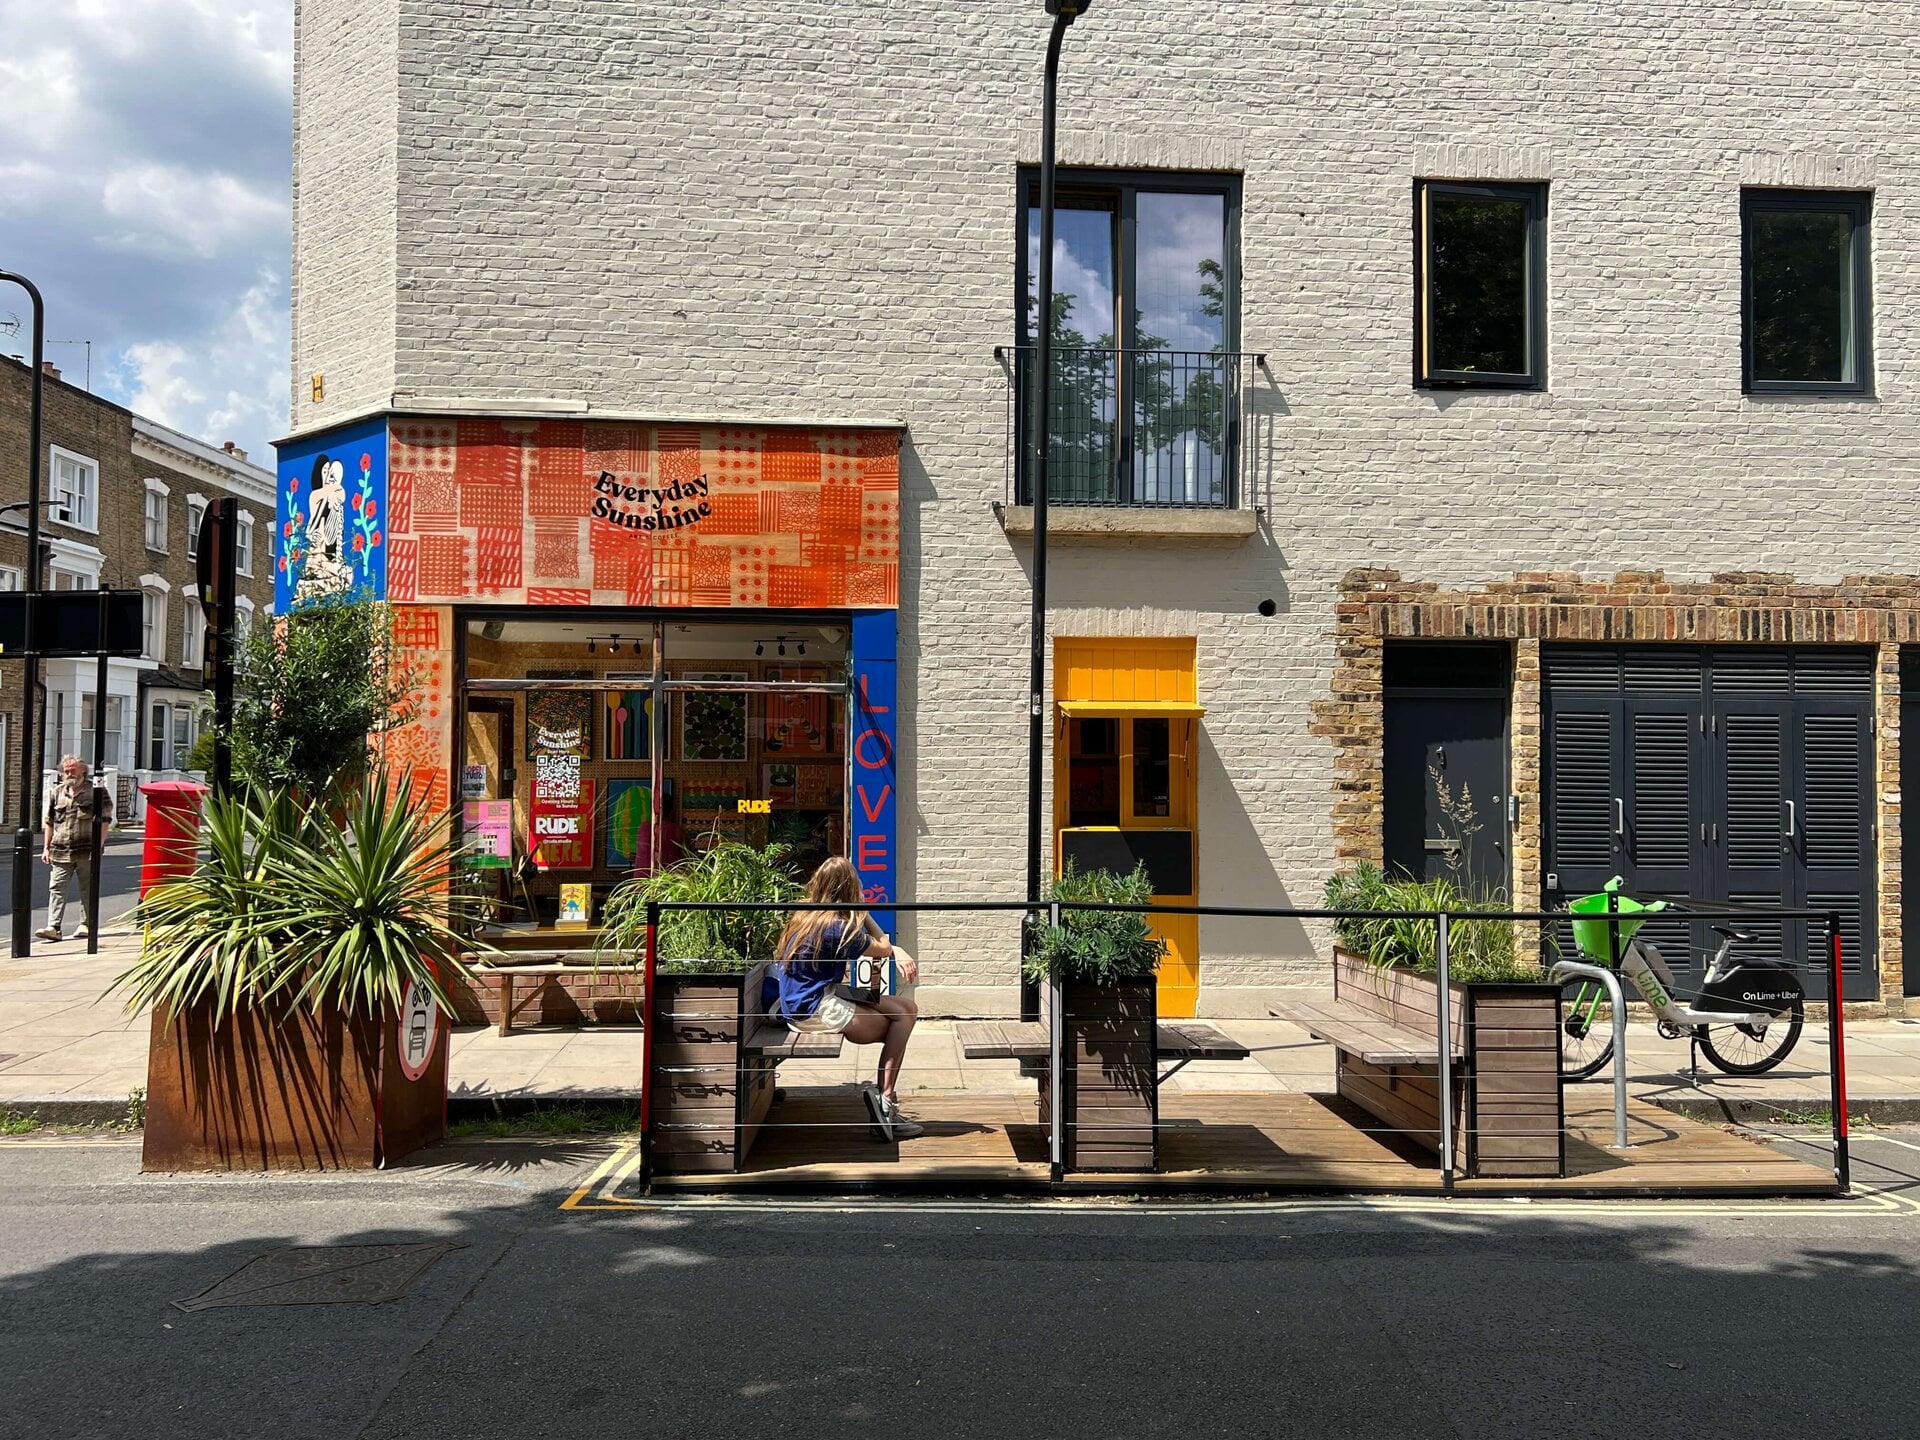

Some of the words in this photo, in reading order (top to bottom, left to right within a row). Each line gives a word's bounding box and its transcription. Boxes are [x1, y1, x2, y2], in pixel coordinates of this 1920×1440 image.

[594, 470, 709, 509] Everyday
[592, 497, 712, 530] Sunshine
[537, 735, 581, 749] Sunshine
[538, 726, 580, 741] Everyday
[855, 673, 893, 871] LOVE
[737, 799, 772, 814] RUDE
[535, 817, 579, 834] RUDE
[1637, 970, 1667, 1007] Lime
[1743, 992, 1756, 1001] On
[1757, 991, 1775, 1000] Lime
[1781, 991, 1799, 1000] Uber
